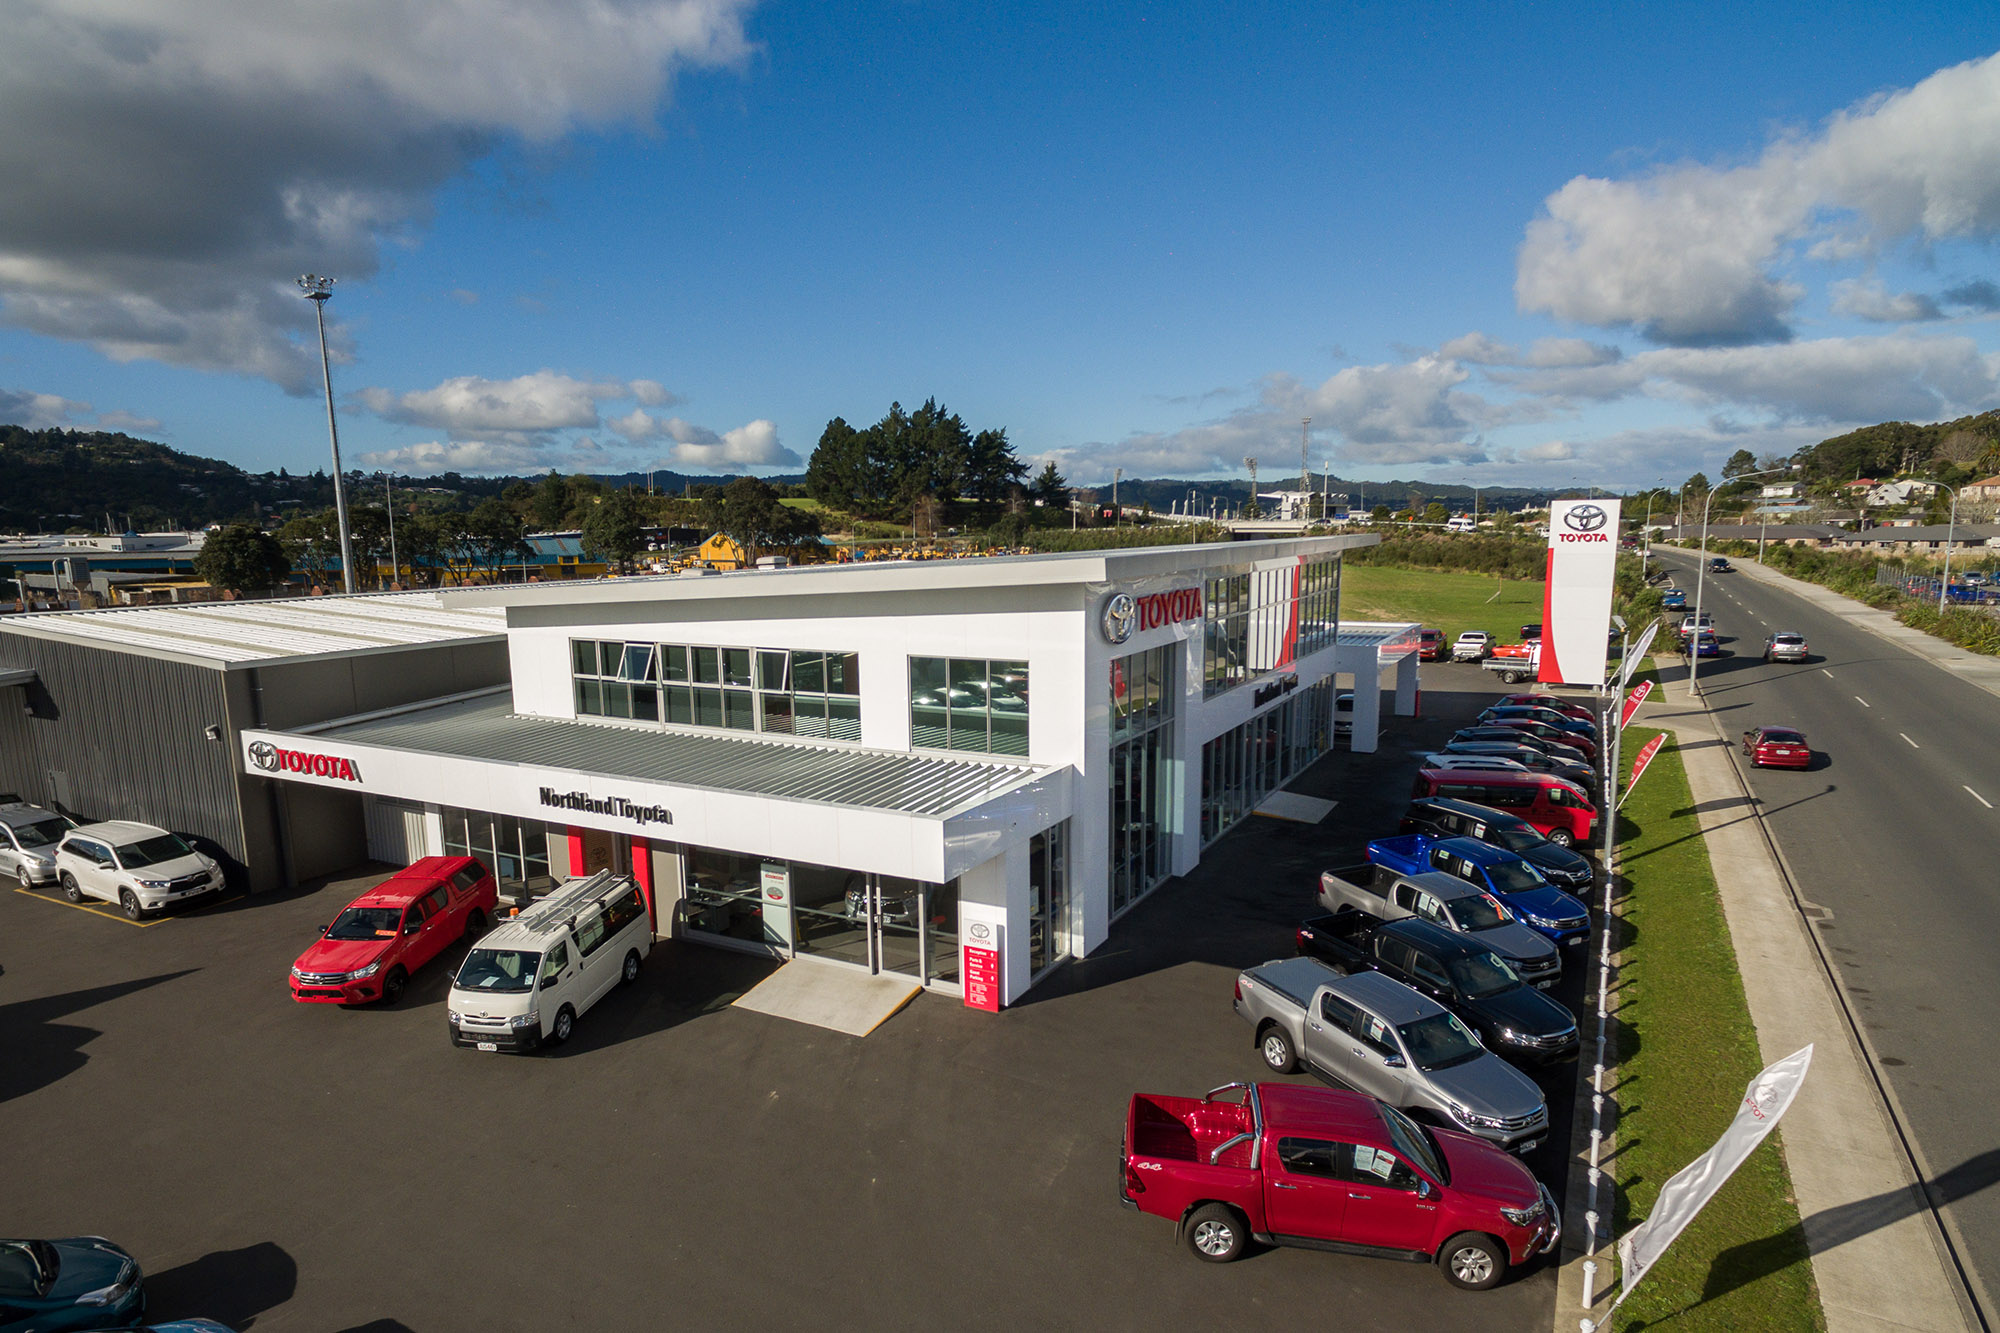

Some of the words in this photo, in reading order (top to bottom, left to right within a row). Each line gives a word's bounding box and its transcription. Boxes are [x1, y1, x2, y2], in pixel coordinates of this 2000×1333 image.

[1559, 533, 1608, 542] TOYOTA
[1137, 587, 1202, 631] TOYOTA
[276, 749, 356, 781] TOYOTA
[539, 787, 614, 816] Northland
[615, 798, 672, 825] Toyota
[969, 937, 991, 945] TOYOTA
